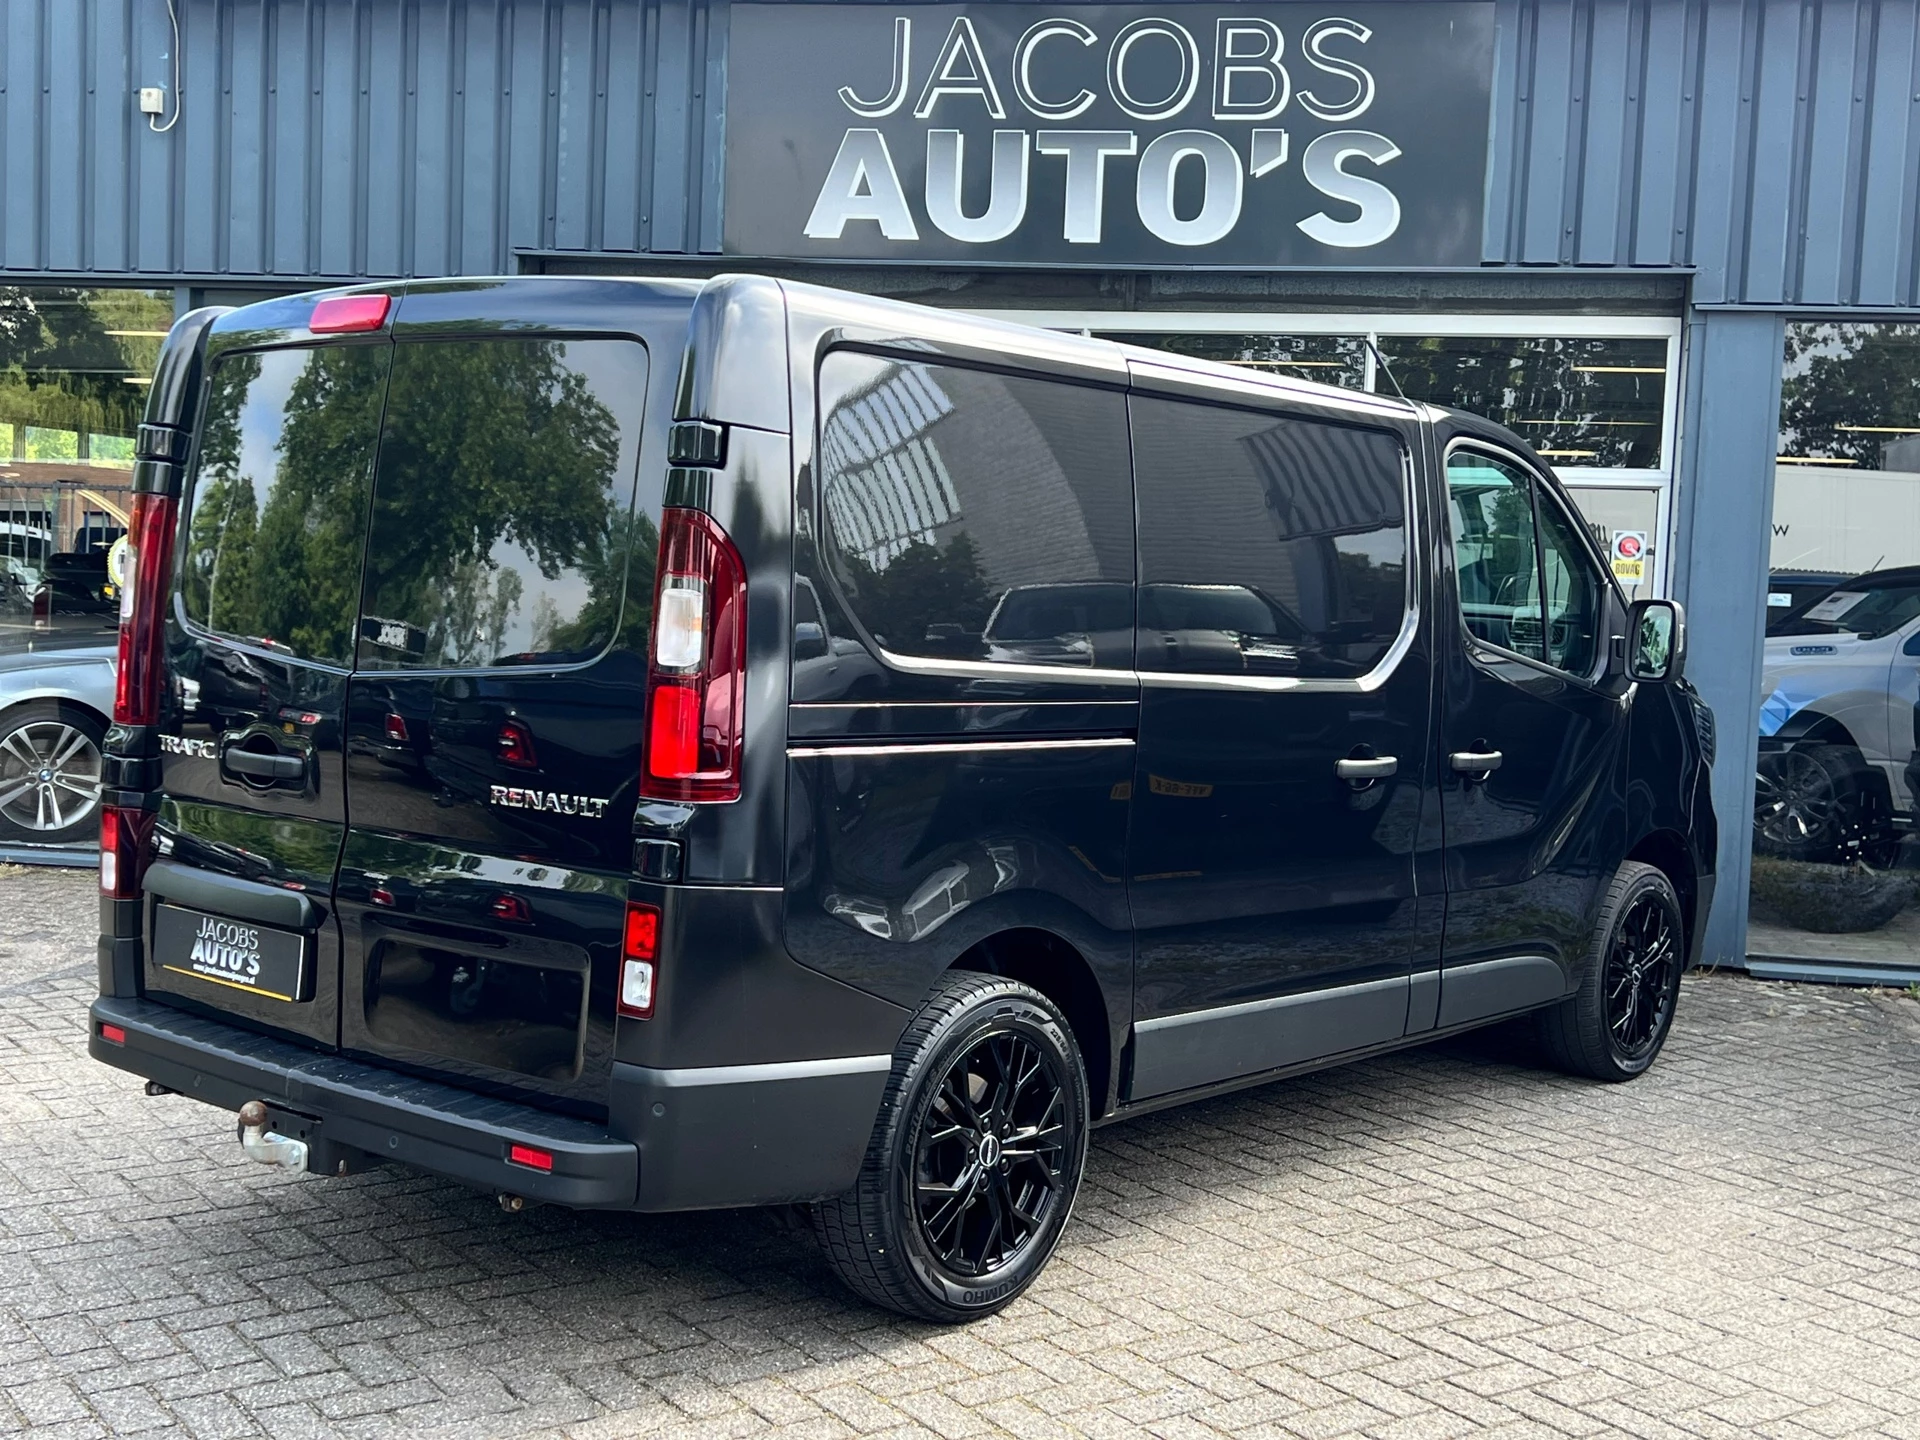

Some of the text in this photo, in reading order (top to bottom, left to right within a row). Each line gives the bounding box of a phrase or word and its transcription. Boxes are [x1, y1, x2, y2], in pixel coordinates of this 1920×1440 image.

[837, 16, 1376, 121] JACOBS
[803, 128, 1402, 247] AUTO'S
[158, 733, 216, 760] TRAFIC
[490, 784, 610, 819] RENAULT
[196, 916, 259, 951] JACOBS
[190, 937, 261, 976] AUTO'S
[962, 1274, 1019, 1304] KUMHO
